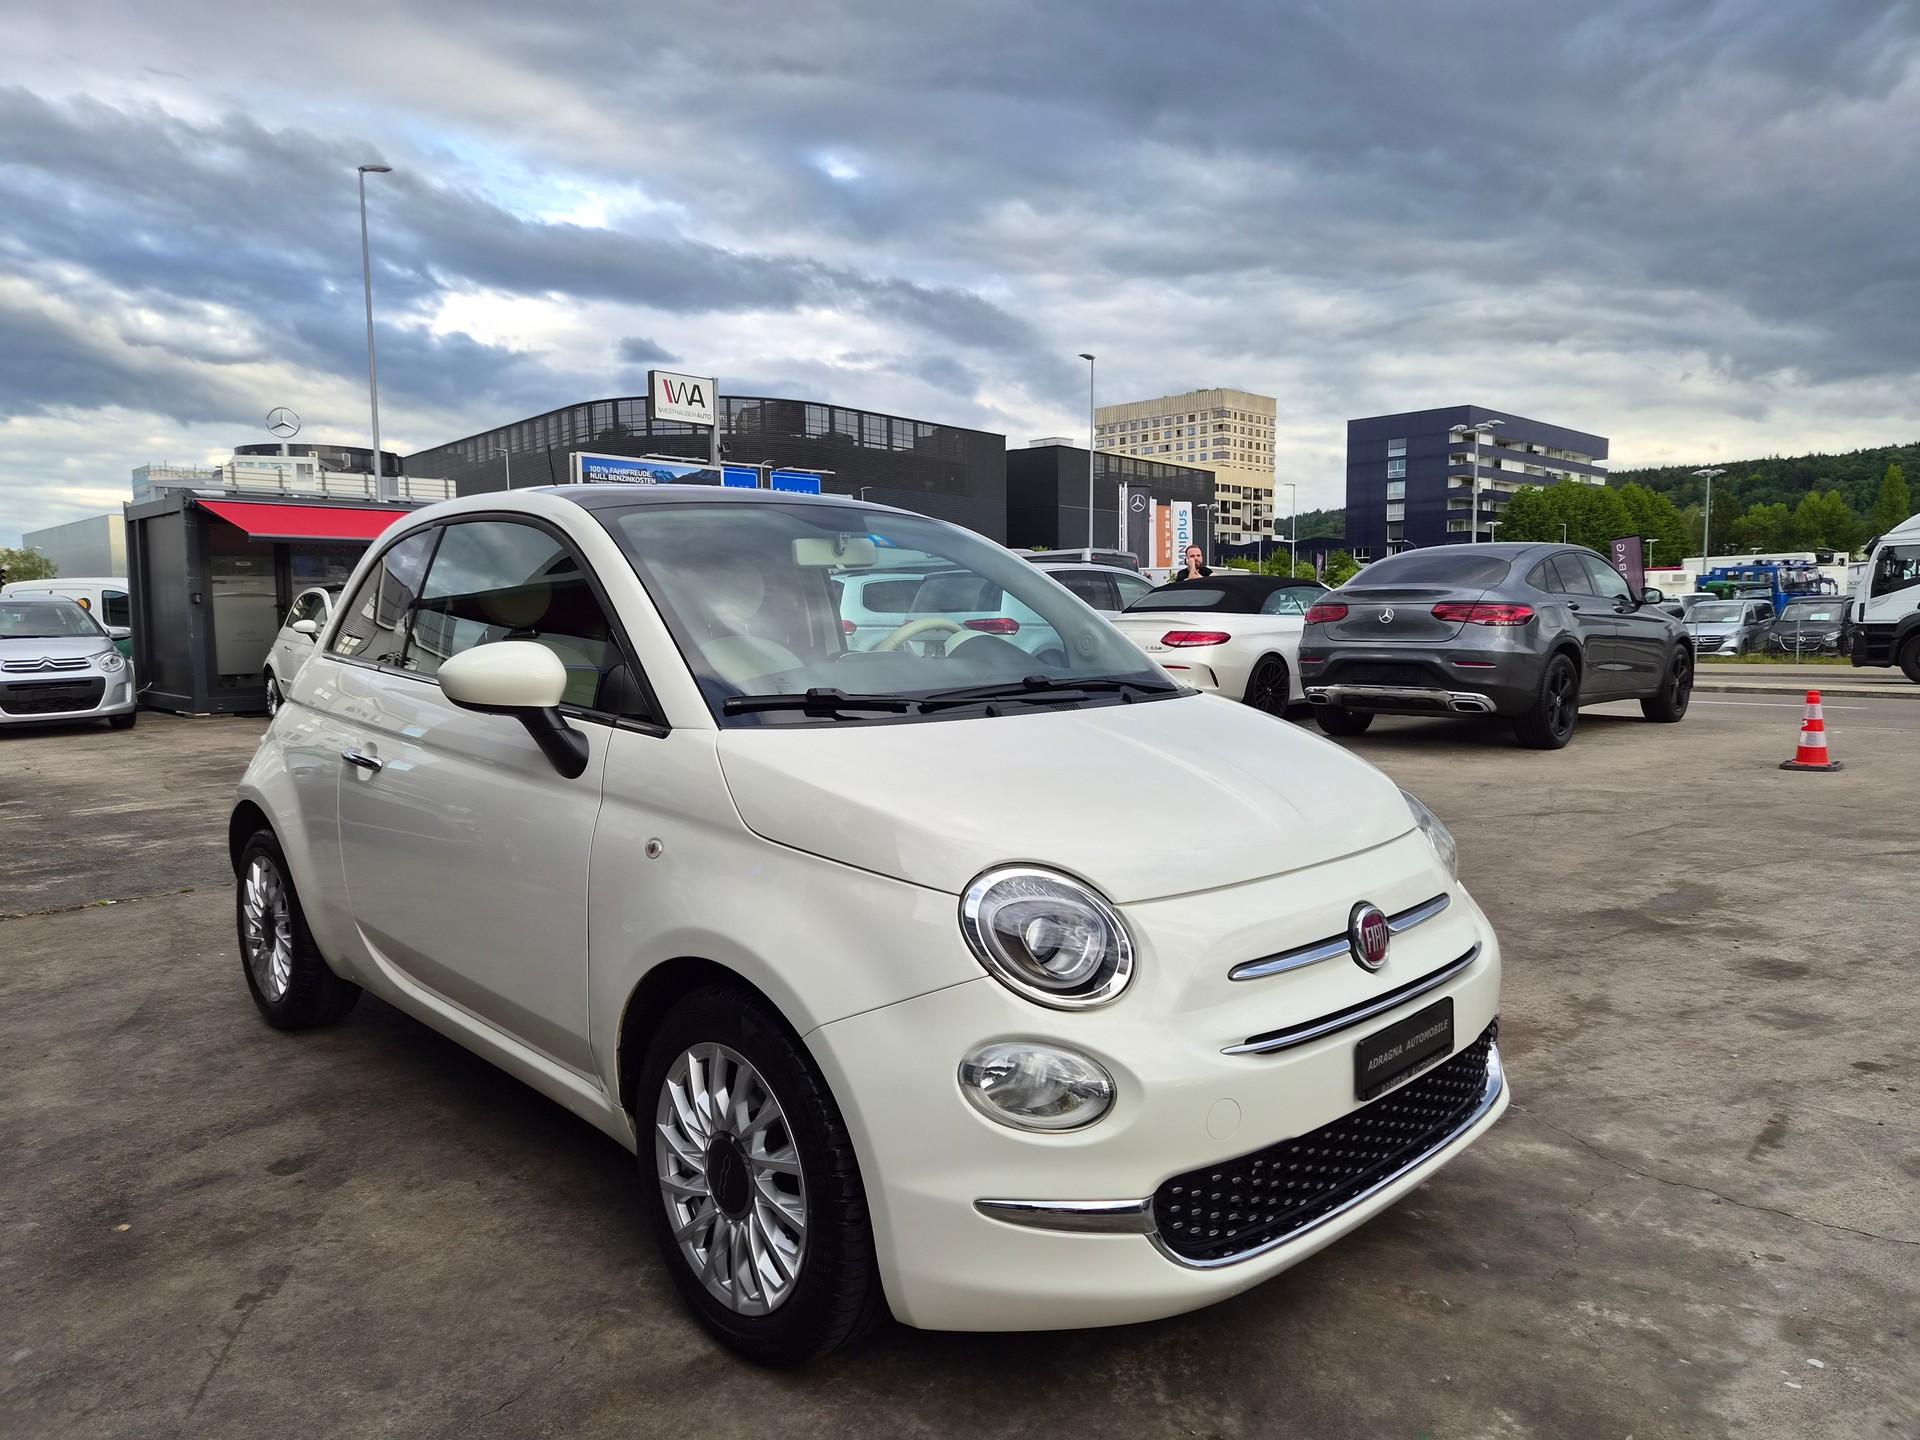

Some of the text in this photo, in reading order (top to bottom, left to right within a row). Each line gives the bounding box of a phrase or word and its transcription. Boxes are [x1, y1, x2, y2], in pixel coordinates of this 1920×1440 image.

[589, 465, 601, 473] 100
[589, 472, 607, 481] NULL
[1176, 509, 1189, 566] MNIplus
[1365, 923, 1385, 954] FIAT
[1367, 1019, 1449, 1072] ADRAGNA AUTOMOBILE
